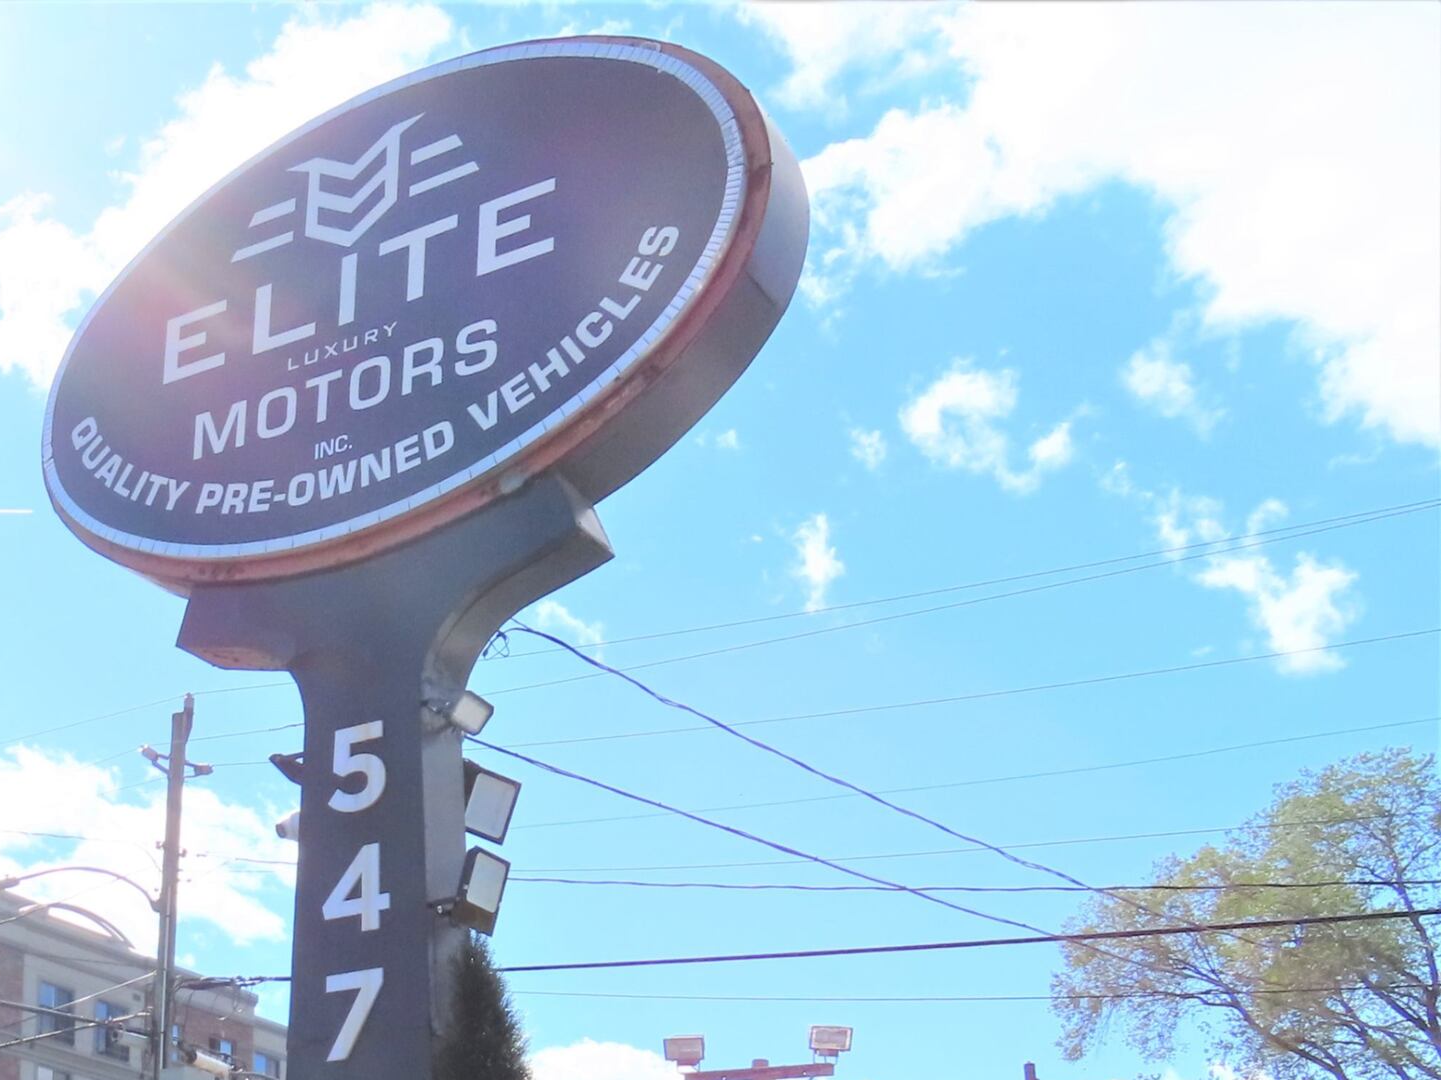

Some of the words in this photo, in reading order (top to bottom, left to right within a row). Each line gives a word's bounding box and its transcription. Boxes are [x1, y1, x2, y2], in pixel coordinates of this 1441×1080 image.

[162, 177, 557, 386] ELITE
[287, 320, 398, 372] LUXURY
[70, 416, 191, 512] QUALITY
[194, 420, 456, 515] PRE-OWNED
[467, 223, 681, 433] VEHICLES
[192, 317, 499, 460] MOTORS
[313, 434, 353, 461] INC.
